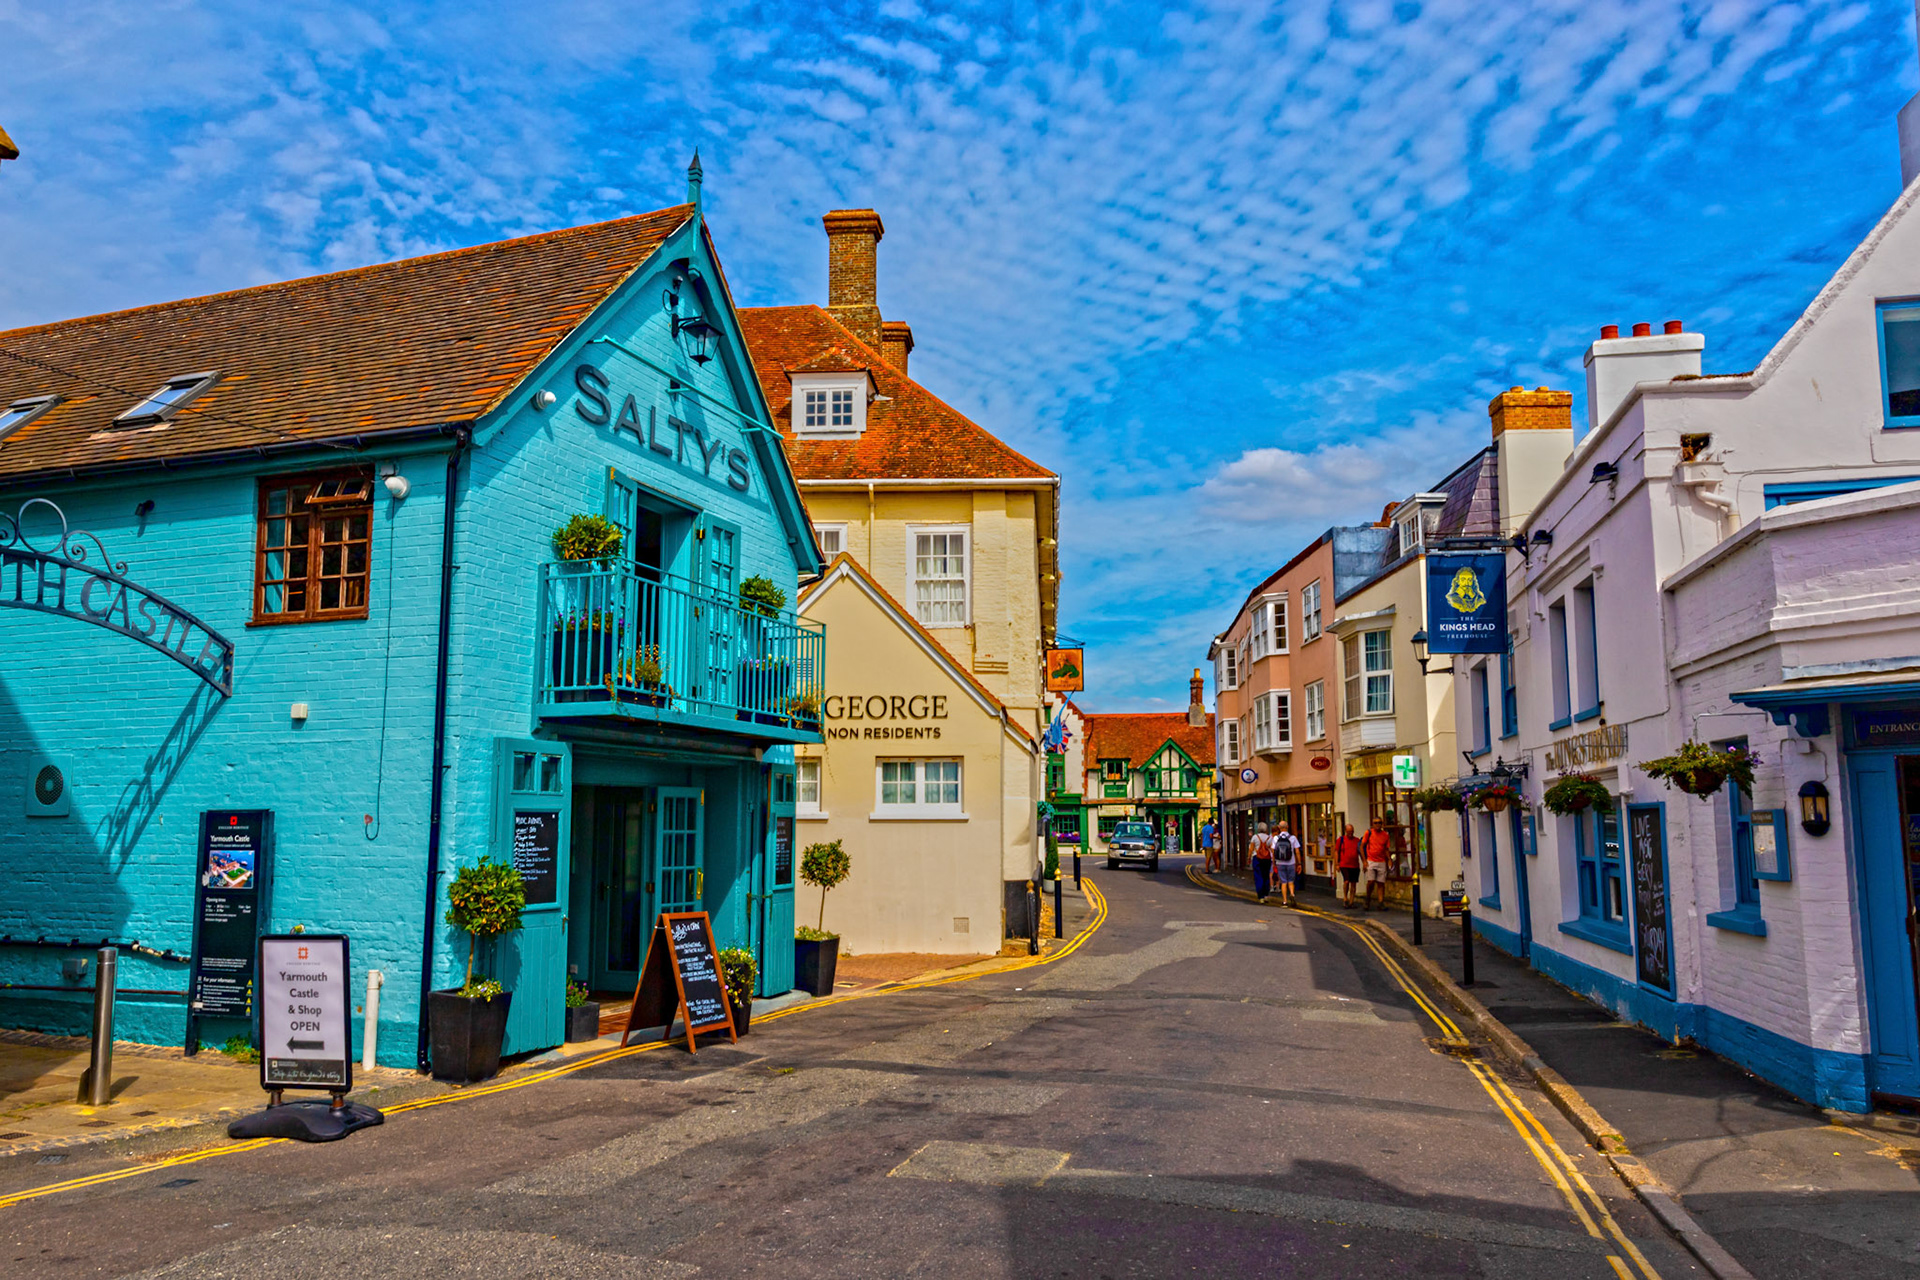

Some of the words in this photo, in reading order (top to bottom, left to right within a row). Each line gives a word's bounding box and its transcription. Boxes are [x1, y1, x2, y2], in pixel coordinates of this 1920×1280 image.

[576, 363, 750, 492] SALTY'S
[0, 552, 68, 612] TH
[80, 575, 228, 677] CASTLE
[1439, 623, 1468, 631] KINGS
[1469, 623, 1496, 631] HEAD
[824, 695, 949, 720] GEORGE
[828, 727, 859, 739] NON
[864, 727, 941, 739] RESIDENTS
[1870, 722, 1920, 734] ENTRANC
[1634, 814, 1651, 838] LIVE
[210, 834, 234, 842] Yarmouth
[279, 971, 328, 982] Yarmouth
[289, 988, 319, 998] Castle
[288, 1004, 296, 1015] &
[298, 1004, 322, 1017] Shop
[290, 1021, 320, 1031] OPEN
